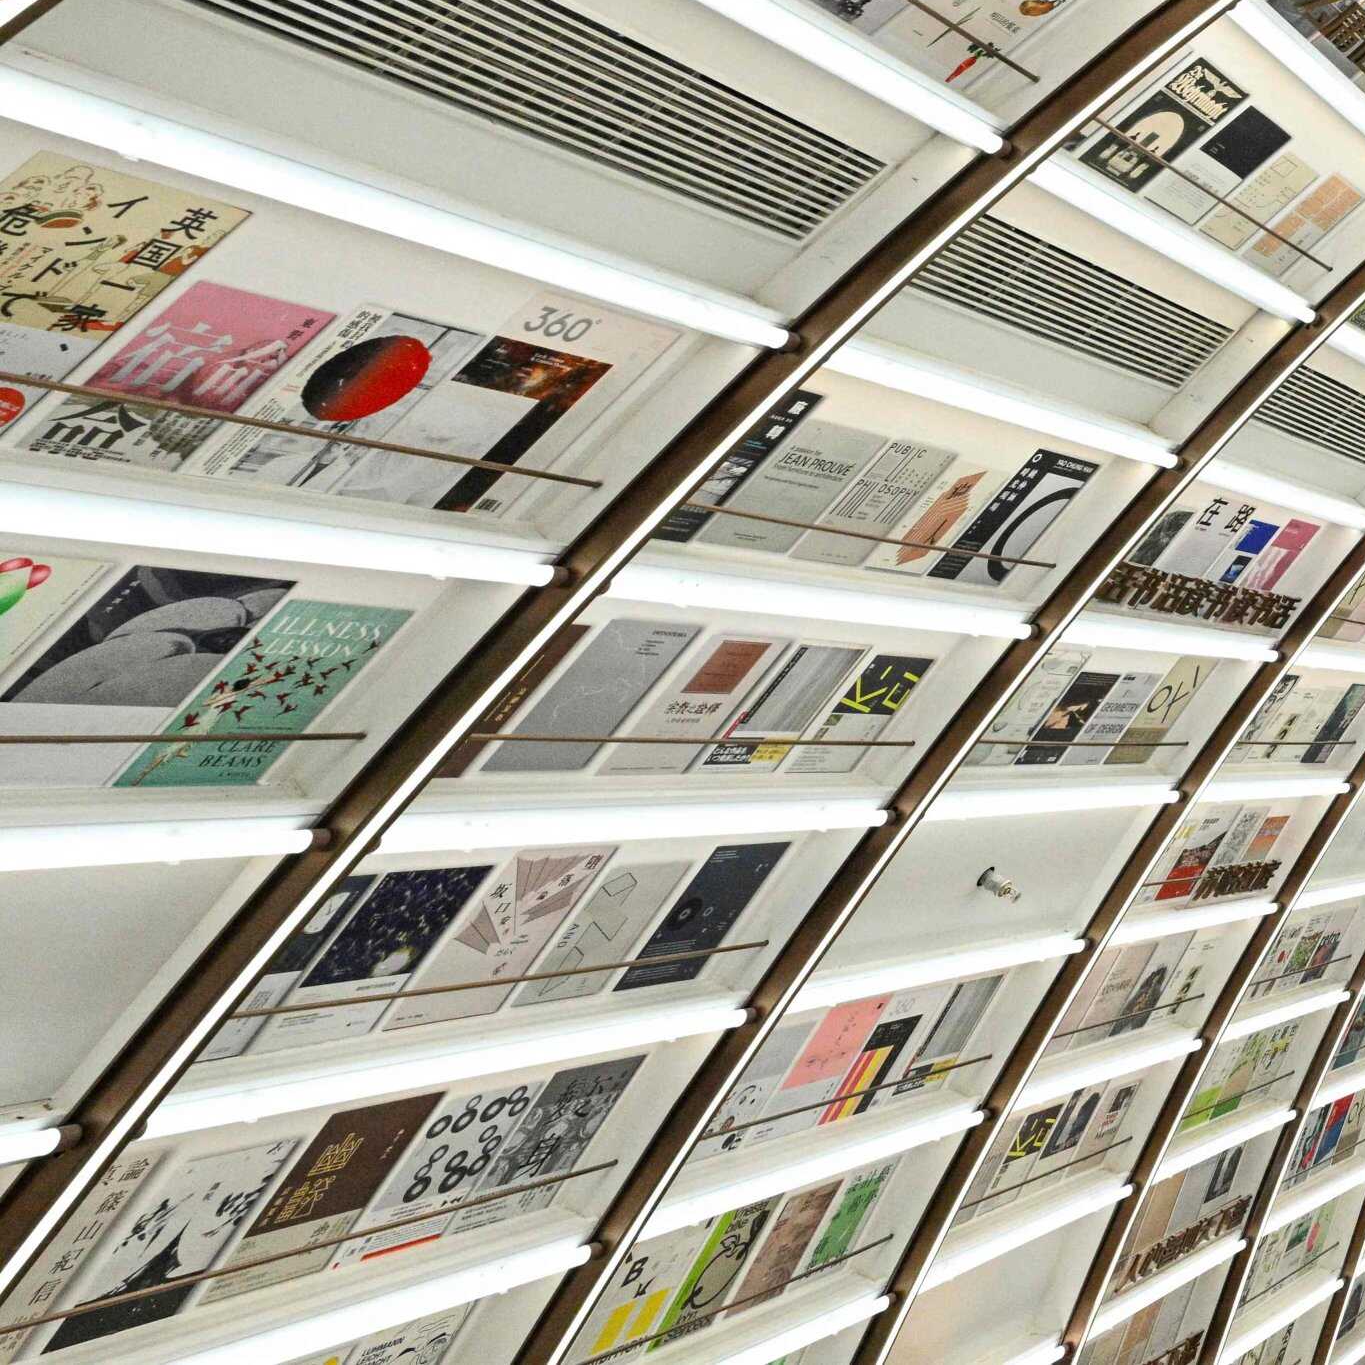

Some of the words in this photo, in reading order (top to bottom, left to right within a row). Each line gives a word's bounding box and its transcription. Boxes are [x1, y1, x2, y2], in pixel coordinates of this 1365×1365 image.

[777, 452, 813, 469] JEAN
[810, 456, 857, 477] PROUVÉ
[267, 616, 388, 638] ILLNESS
[263, 639, 354, 658] LESSON
